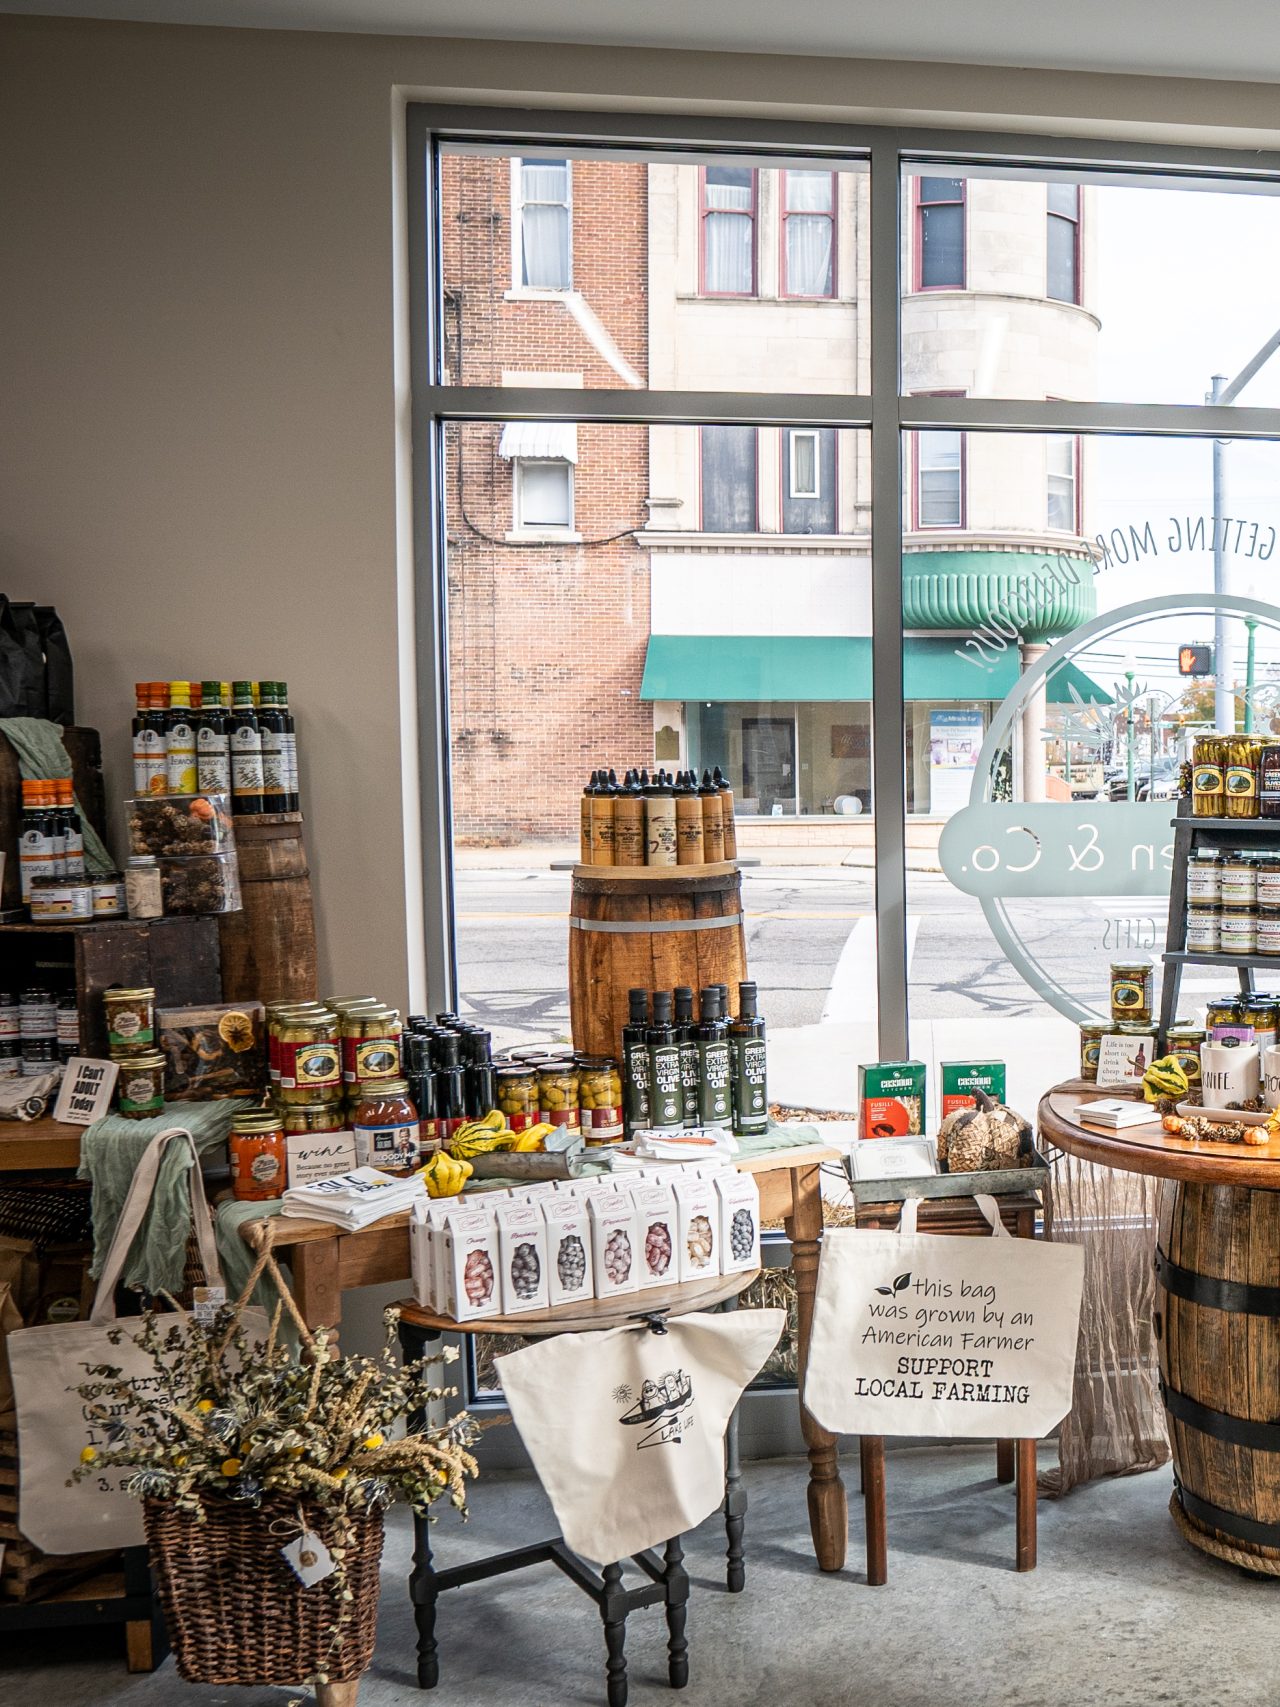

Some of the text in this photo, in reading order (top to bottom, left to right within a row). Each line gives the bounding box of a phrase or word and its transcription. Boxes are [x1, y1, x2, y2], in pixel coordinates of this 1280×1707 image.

[706, 1050, 728, 1059] GREEK
[744, 1046, 766, 1055] GREEK
[655, 1055, 679, 1063] GREEK
[706, 1057, 729, 1066] EXTRA
[744, 1054, 766, 1062] EXTRA
[656, 1062, 680, 1070] EXTRA
[77, 1065, 105, 1080] I Can't
[707, 1071, 729, 1080] OLIVE
[745, 1067, 766, 1076] OLIVE
[656, 1076, 680, 1084] OLIVE
[711, 1079, 727, 1089] OIL
[750, 1075, 764, 1084] OIL
[73, 1081, 101, 1095] ADULT
[661, 1084, 678, 1093] OIL
[69, 1096, 96, 1112] Today
[296, 1163, 322, 1171] Because
[334, 1161, 350, 1170] great
[912, 1278, 997, 1305] this bag
[868, 1303, 1034, 1329] was grown by an
[861, 1326, 1035, 1351] American Farmer
[897, 1357, 994, 1378] SUPPORT
[854, 1378, 1030, 1404] LOCAL FARMING
[661, 1415, 694, 1441] LAKE LIFE
